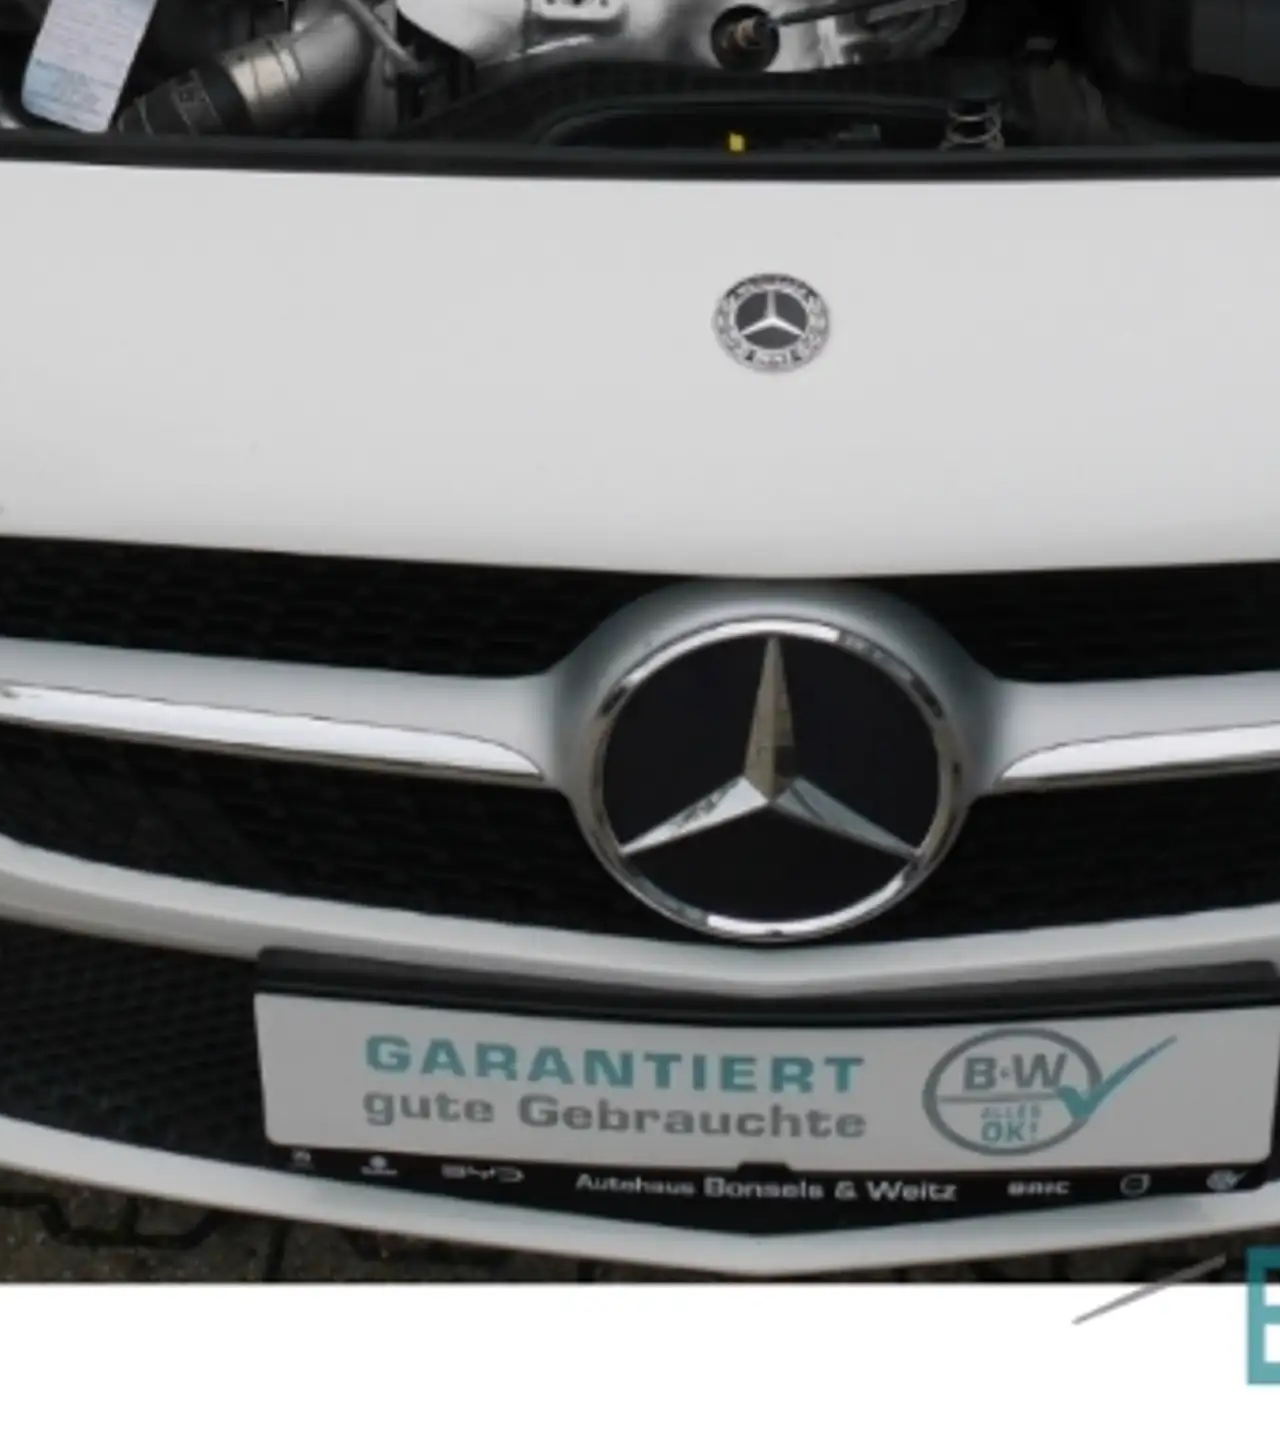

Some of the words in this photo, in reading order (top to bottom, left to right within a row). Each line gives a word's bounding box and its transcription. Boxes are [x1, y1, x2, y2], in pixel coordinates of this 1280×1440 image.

[365, 1035, 864, 1094] GARANTIERT
[362, 1091, 495, 1127] gute
[517, 1093, 868, 1139] Gebrauchte
[575, 1173, 695, 1197] Autohaus
[703, 1176, 824, 1199] Bonsels
[834, 1180, 858, 1201] &
[867, 1180, 958, 1202] Weitz
